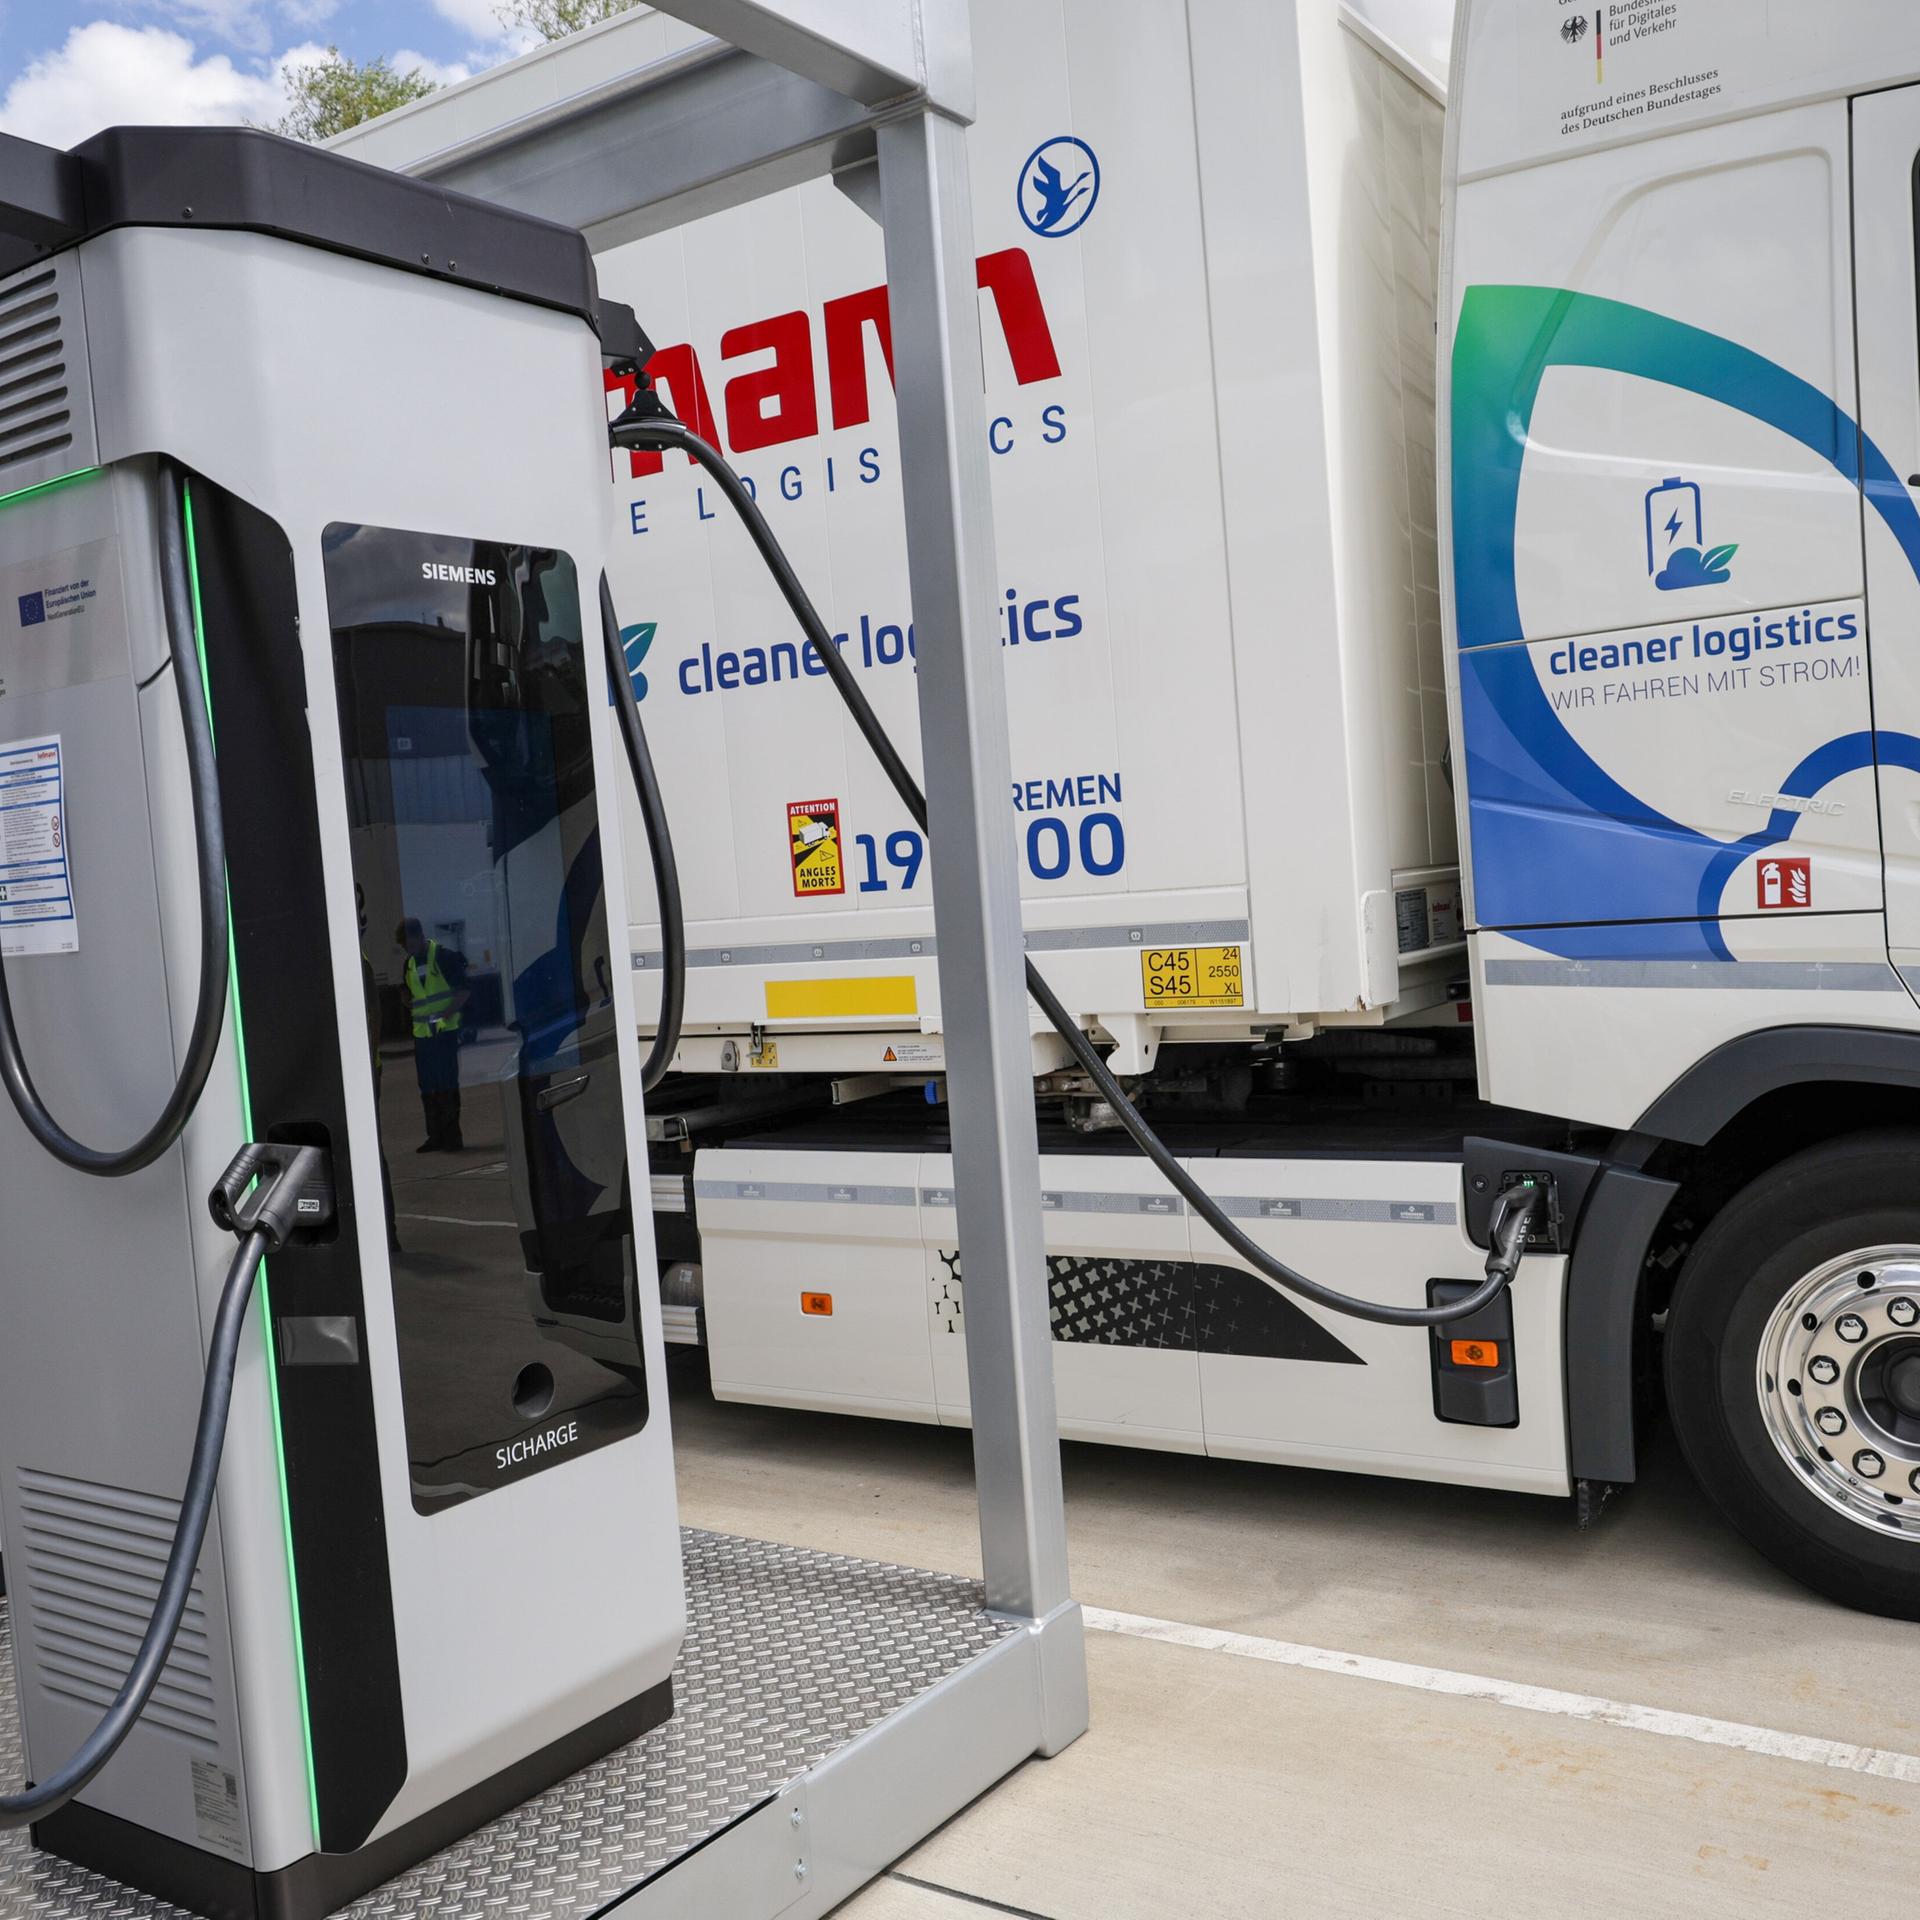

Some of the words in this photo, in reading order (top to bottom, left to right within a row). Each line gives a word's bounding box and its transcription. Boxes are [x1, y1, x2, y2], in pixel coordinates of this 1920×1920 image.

[1609, 19, 1625, 32] für
[1628, 4, 1677, 26] Digitales
[1609, 30, 1631, 46] und
[1633, 18, 1678, 39] Verkehr
[1560, 96, 1613, 121] aufgrund
[1616, 89, 1646, 104] eines
[1648, 69, 1719, 99] Beschlusses
[1561, 122, 1580, 135] des
[1582, 105, 1643, 130] Deutschen
[1647, 84, 1722, 112] Bundestages
[697, 404, 1066, 521] LGISCS
[70, 582, 79, 591] von
[80, 579, 89, 588] der
[421, 562, 497, 586] SIEMENS
[80, 590, 97, 599] Union
[860, 588, 1082, 674] loics
[1549, 634, 1684, 676] cleaner
[1692, 609, 1857, 662] logistics
[1551, 686, 1597, 711] WIR
[1603, 675, 1699, 705] FAHREN
[1707, 667, 1752, 693] MIT
[1760, 654, 1861, 687] STROM!
[790, 803, 835, 815] ATTENTION
[1727, 790, 1847, 817] ELECTRIC
[800, 866, 836, 877] ANGLES
[802, 877, 835, 888] MORTS
[1148, 951, 1190, 972] C45
[1222, 948, 1238, 960] 24
[1208, 965, 1240, 978] 2550
[1150, 975, 1191, 996] S45
[1224, 982, 1241, 994] XL
[495, 1421, 578, 1469] SICHARGE
